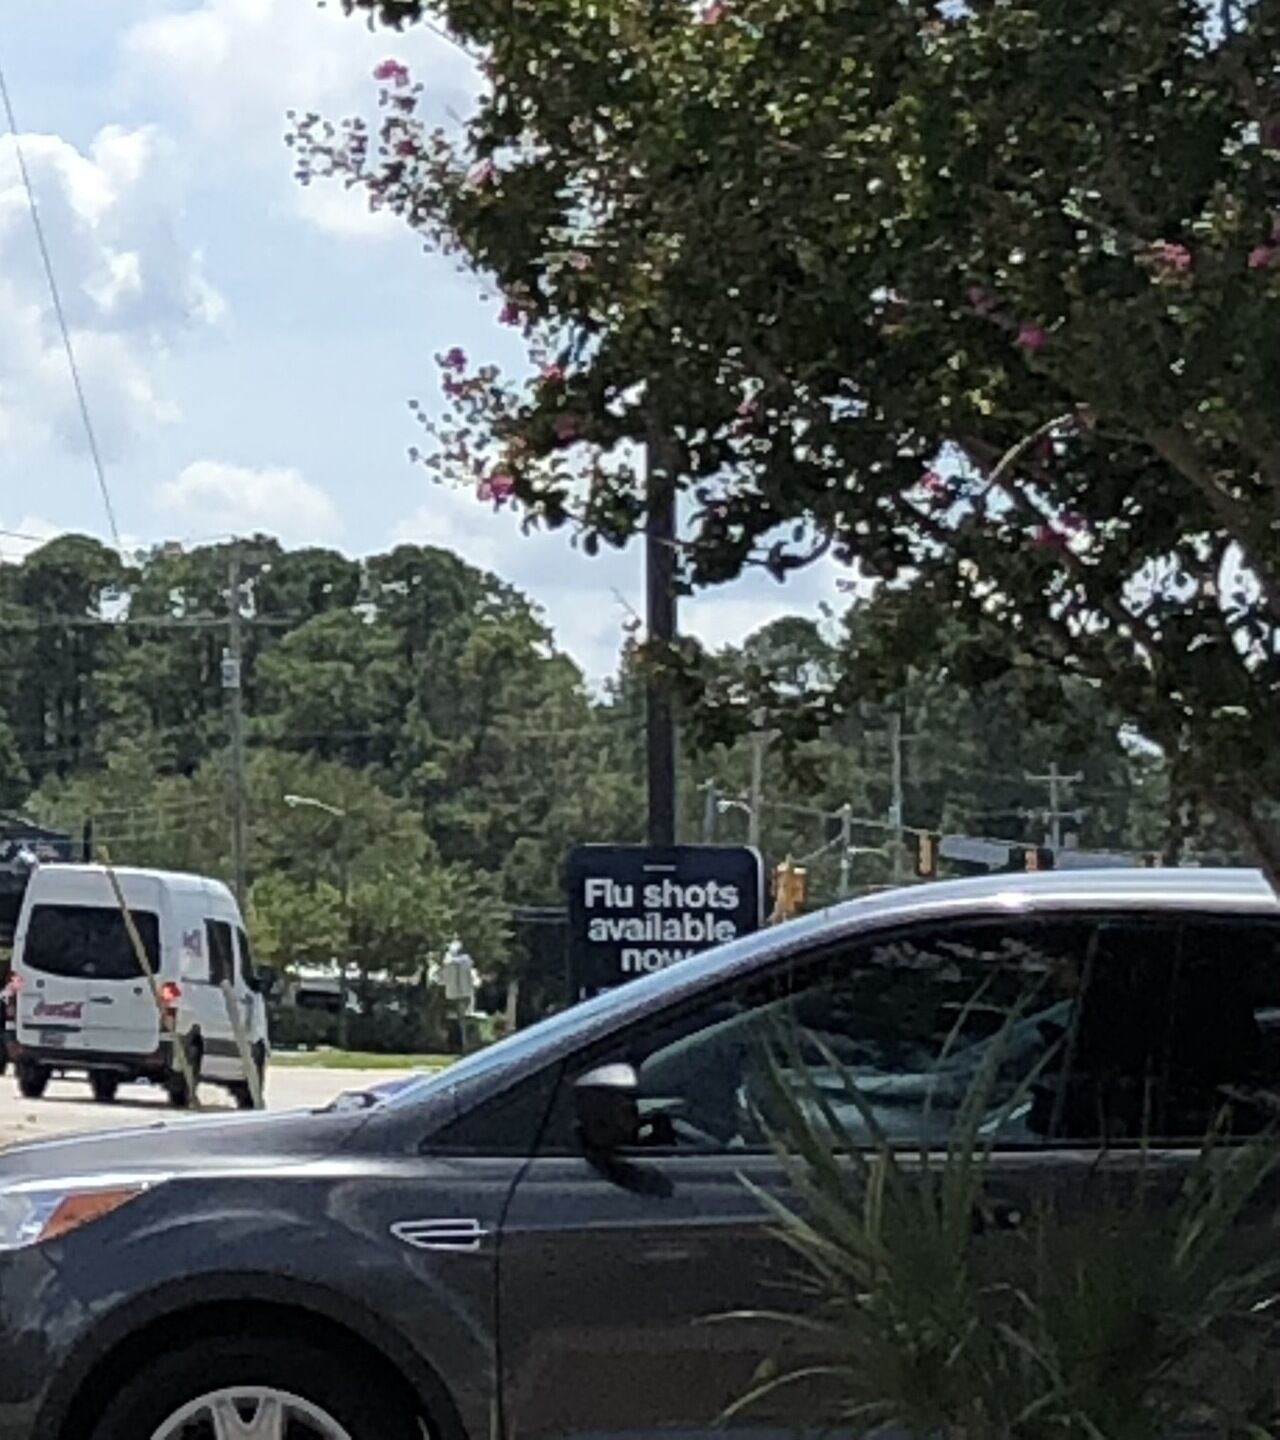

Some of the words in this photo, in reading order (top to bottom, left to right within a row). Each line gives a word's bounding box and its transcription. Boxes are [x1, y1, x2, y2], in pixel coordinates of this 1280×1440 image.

[584, 878, 634, 908] Flu
[643, 879, 740, 909] shots
[587, 912, 737, 942] available
